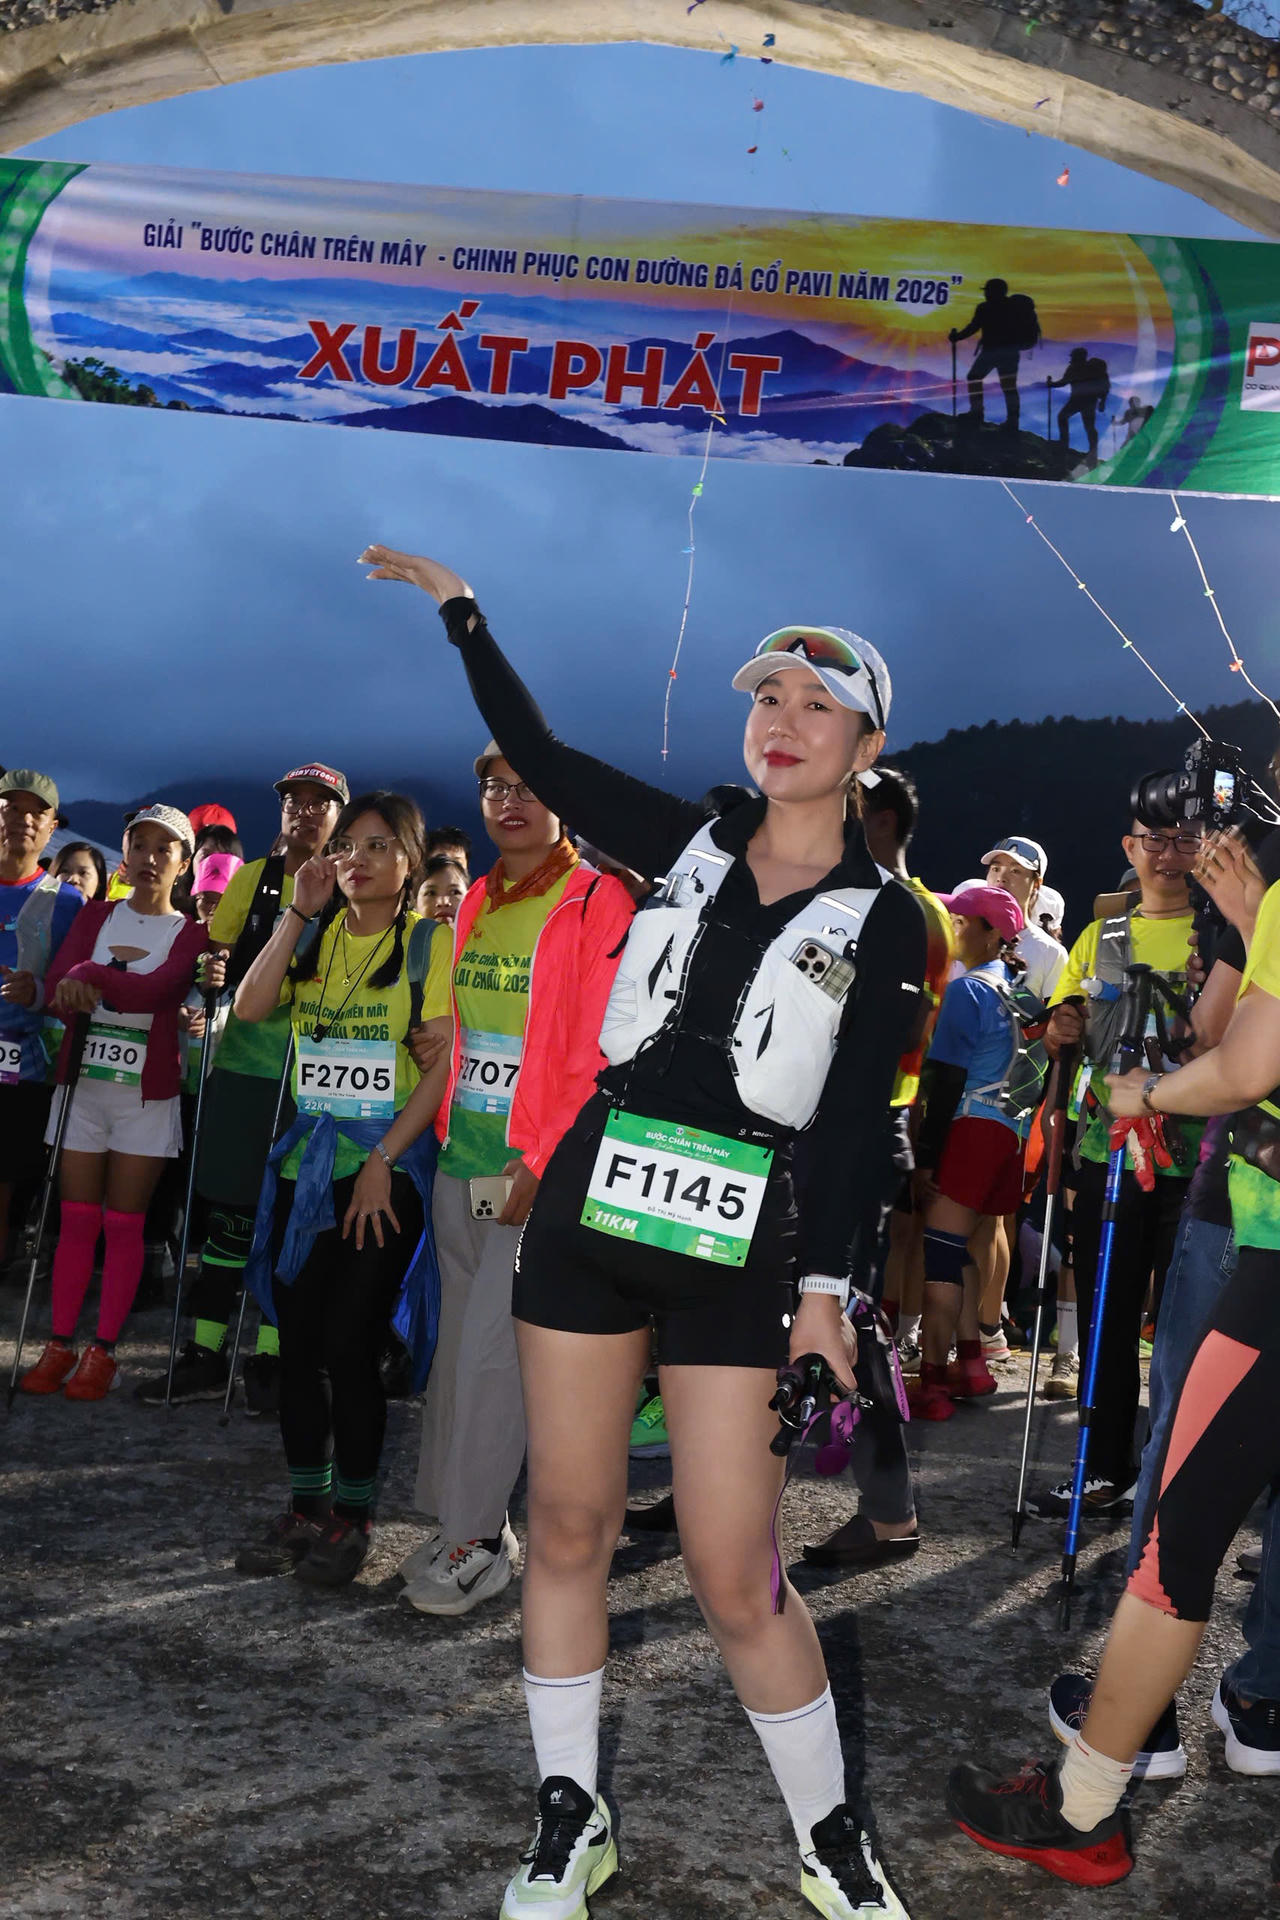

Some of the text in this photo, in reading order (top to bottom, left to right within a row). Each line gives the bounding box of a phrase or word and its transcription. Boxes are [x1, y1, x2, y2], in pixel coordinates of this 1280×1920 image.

[144, 218, 183, 249] GIẢI
[191, 221, 254, 255] "BƯỚC
[261, 230, 316, 259] CHÂN
[323, 235, 374, 263] TRÊN
[380, 239, 427, 267] MÂY
[453, 247, 517, 274] CHINH
[523, 252, 580, 282] PHỤC
[586, 256, 630, 282] CON
[635, 256, 709, 288] ĐƯỜNG
[714, 262, 743, 291] ĐÁ
[750, 260, 783, 293] CỔ
[785, 270, 833, 297] PAVI
[838, 271, 890, 301] NĂM
[297, 300, 783, 417] XUẤT PHÁT
[454, 968, 530, 994] LAI CHÂU 202
[366, 1003, 388, 1017] MÂY
[352, 1024, 389, 1041] 2026
[301, 1063, 391, 1091] F2705
[304, 1101, 332, 1112] 22KM
[646, 1131, 668, 1142] BƯỚC
[668, 1136, 691, 1148] CHÂN
[692, 1142, 713, 1154] TRÊN
[713, 1148, 731, 1159] MÂY
[605, 1154, 747, 1220] F1145
[594, 1210, 639, 1233] 11KM
